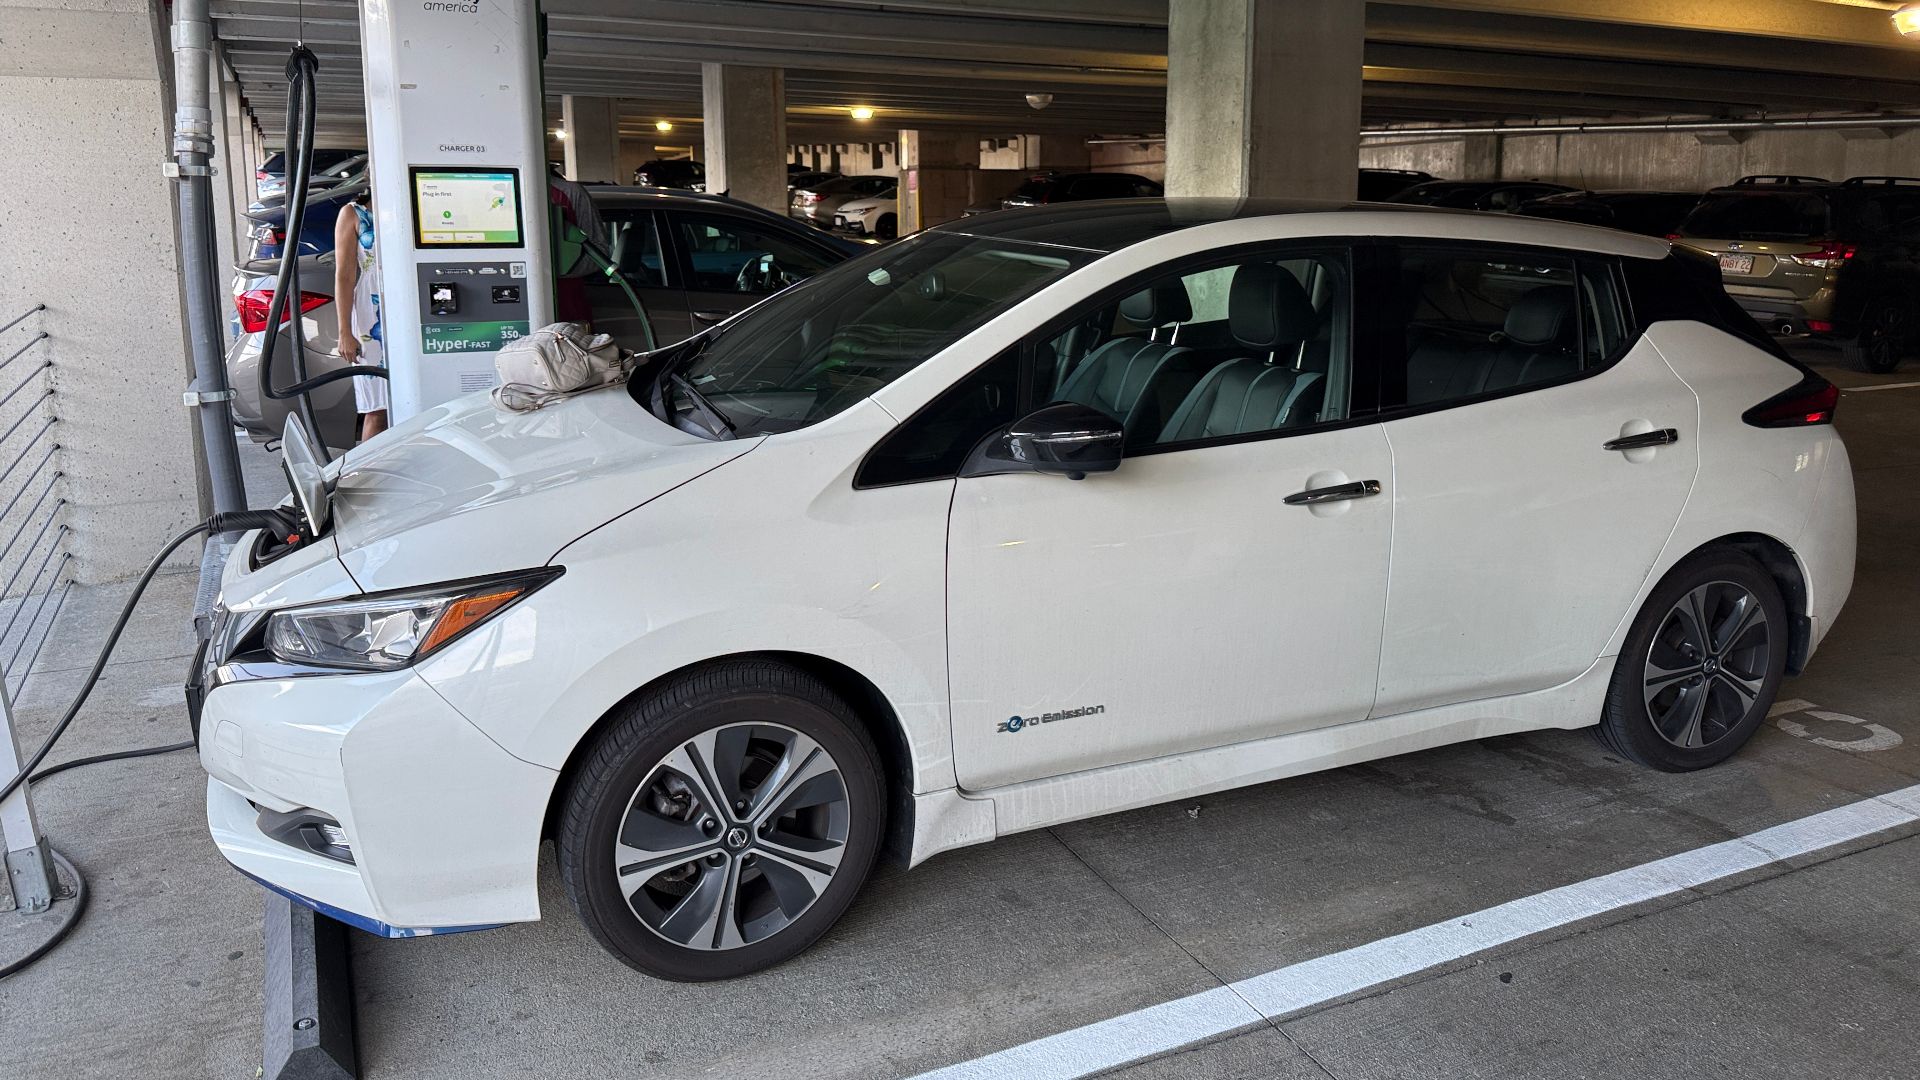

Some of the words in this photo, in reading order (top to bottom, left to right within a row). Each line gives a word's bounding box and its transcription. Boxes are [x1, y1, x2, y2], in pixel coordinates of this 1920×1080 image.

[423, 2, 478, 13] america
[476, 145, 486, 153] 03
[1740, 260, 1751, 270] 22
[500, 330, 519, 339] 350
[426, 338, 492, 352] Hyper-FAST
